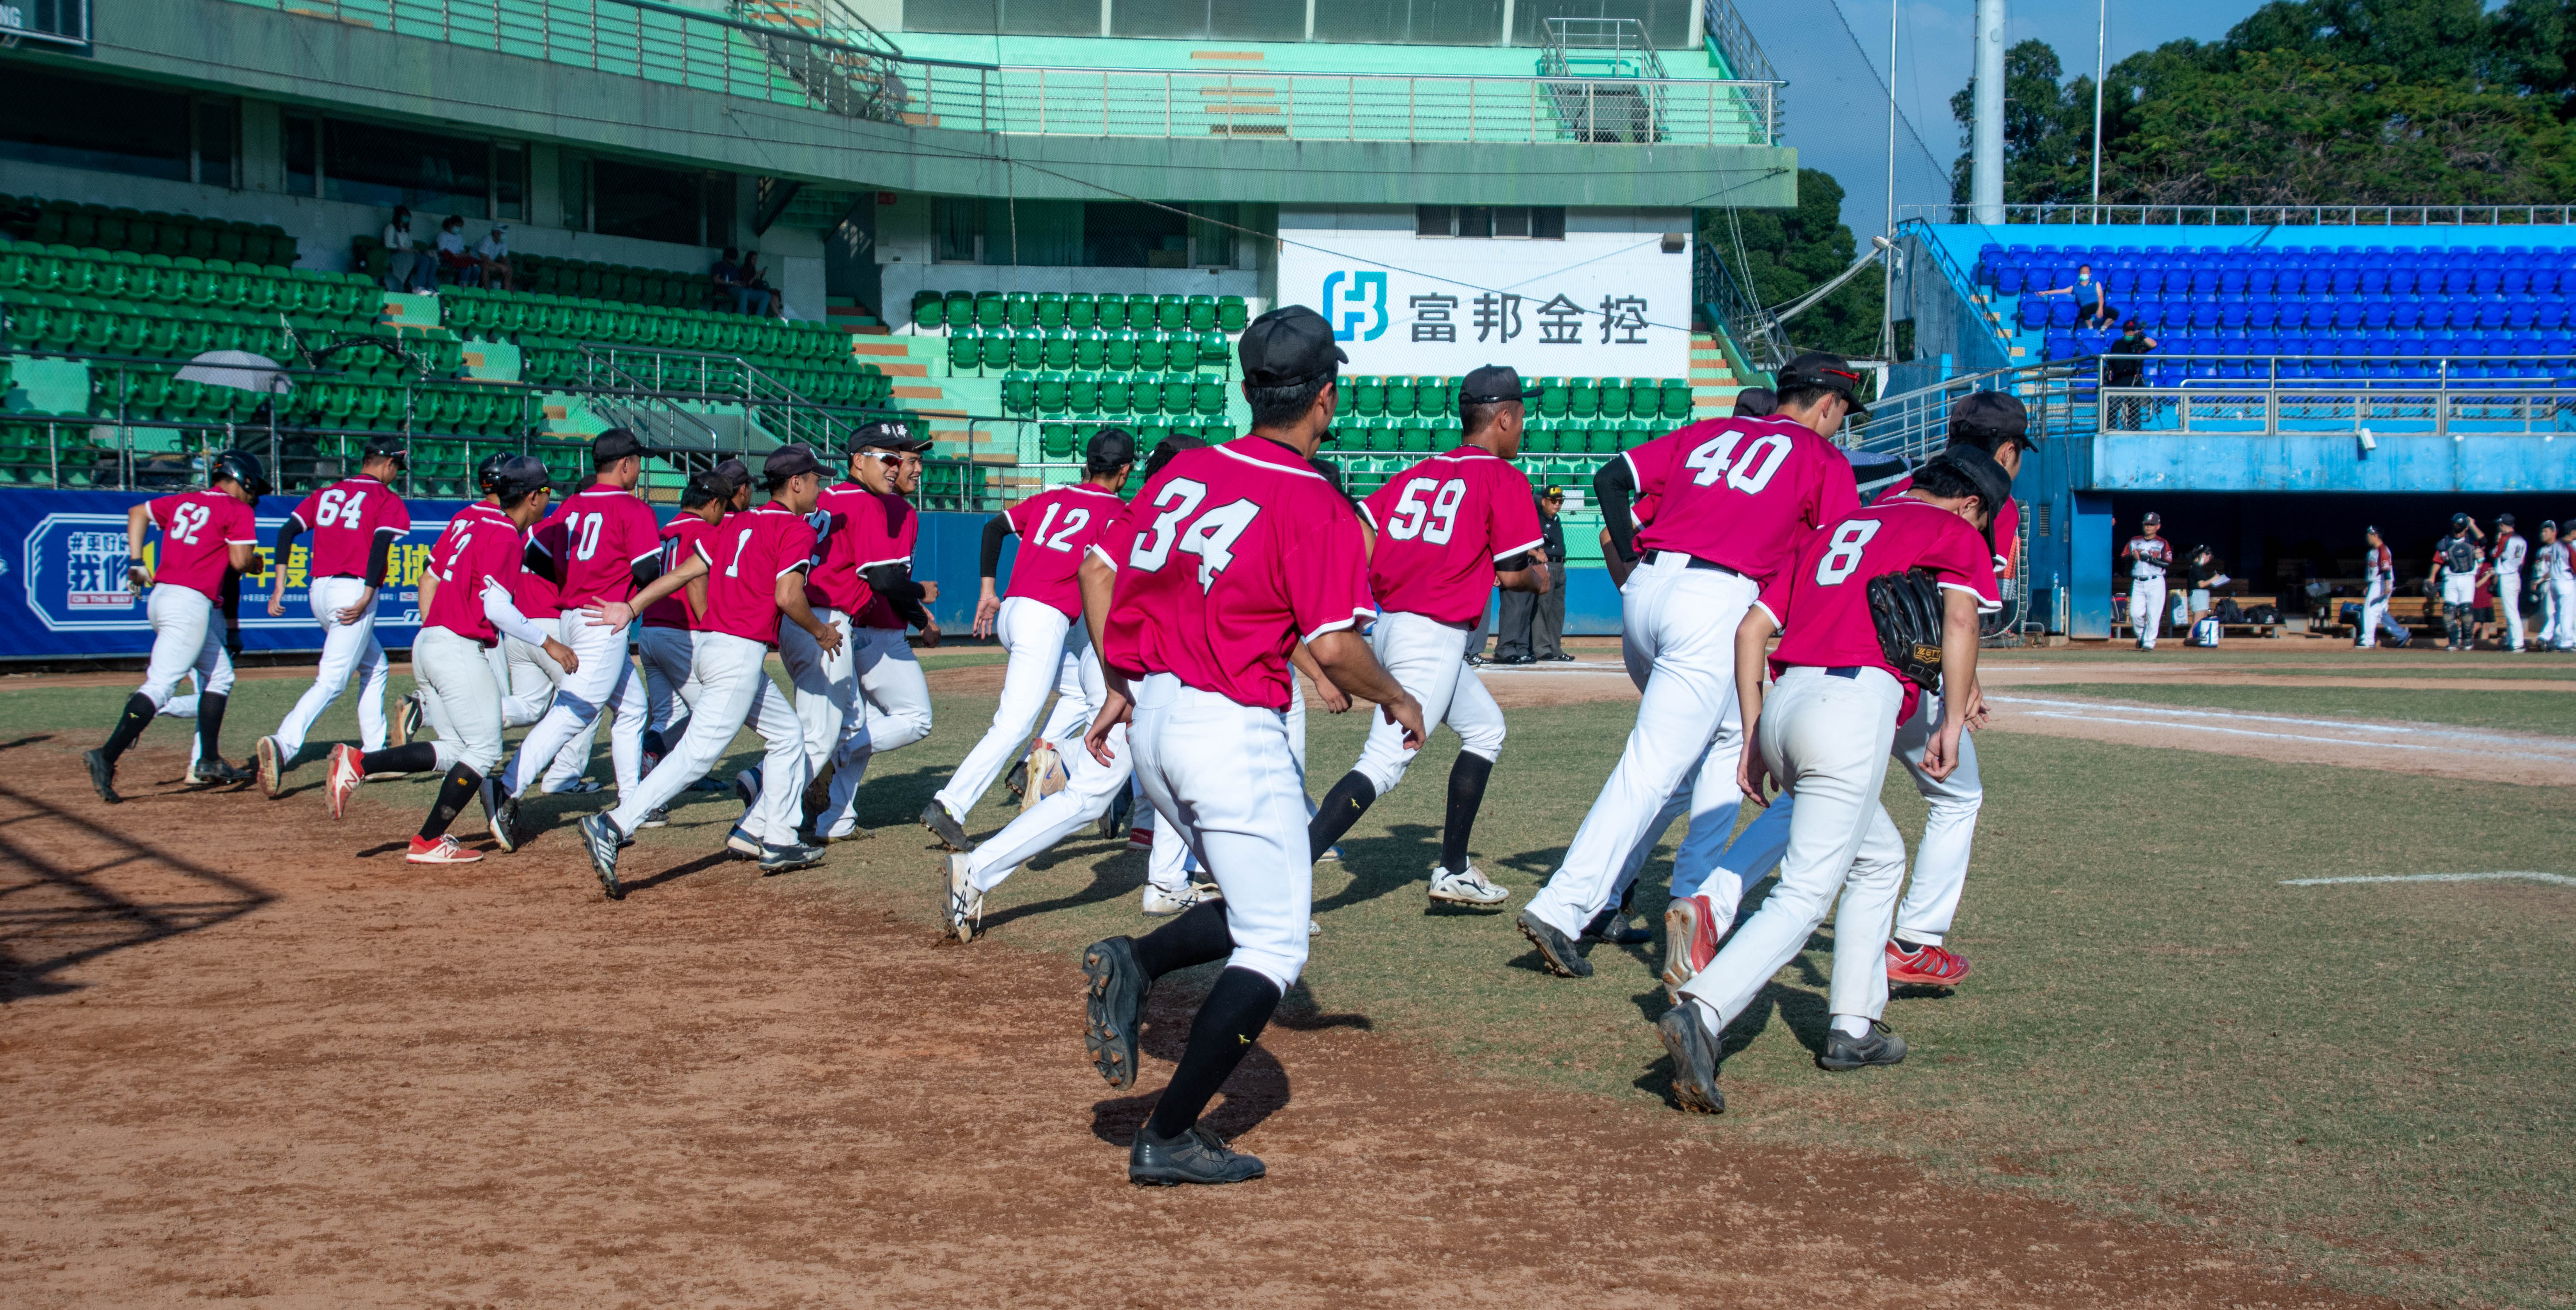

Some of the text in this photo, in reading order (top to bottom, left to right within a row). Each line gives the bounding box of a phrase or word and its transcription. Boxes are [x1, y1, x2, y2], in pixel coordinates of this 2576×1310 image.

[1410, 292, 1650, 344] 富邦金控
[1684, 429, 1794, 496] 40
[170, 501, 211, 545] 52
[316, 488, 367, 530] 64
[1033, 501, 1091, 553] 12
[1386, 476, 1468, 546] 59
[565, 511, 603, 561] 10
[725, 528, 752, 578] 1
[1128, 475, 1263, 598] 34
[1815, 518, 1883, 587] 8
